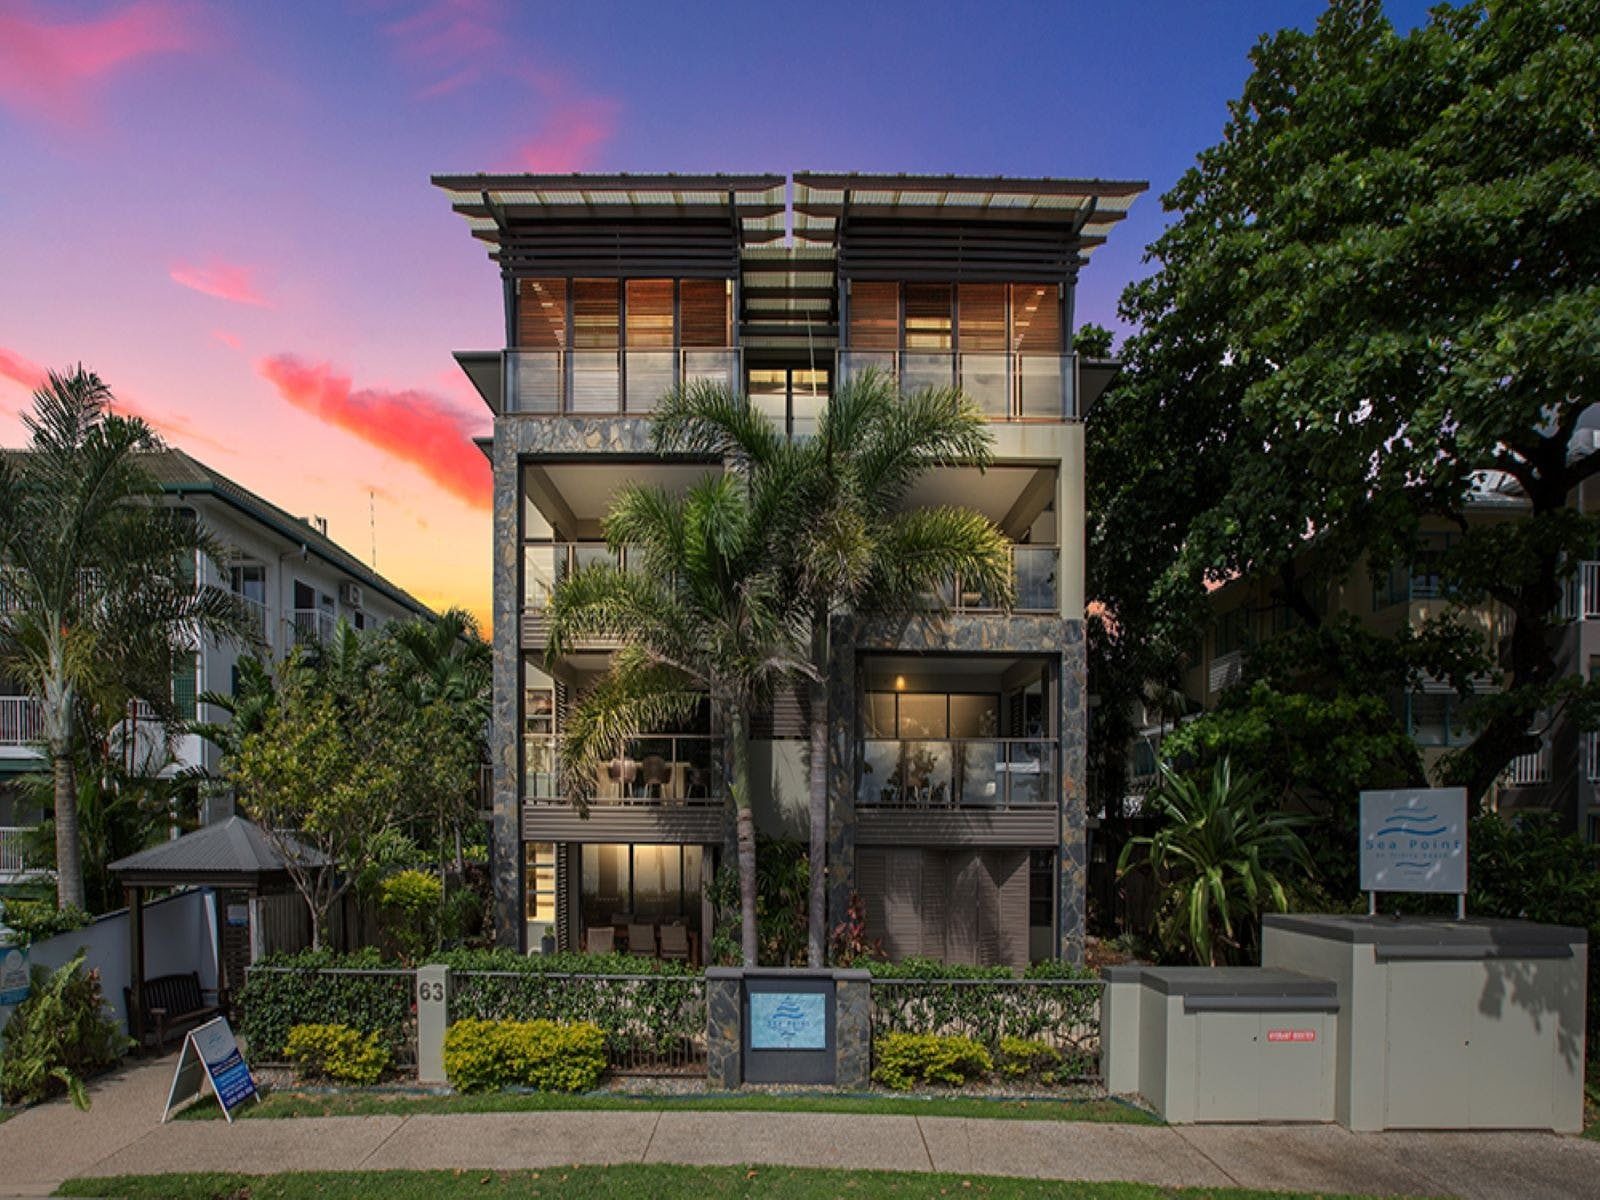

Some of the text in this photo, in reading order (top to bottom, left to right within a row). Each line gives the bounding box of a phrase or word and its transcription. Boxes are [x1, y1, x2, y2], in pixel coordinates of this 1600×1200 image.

[1365, 839, 1460, 849] Sea Point
[420, 982, 444, 1001] 63
